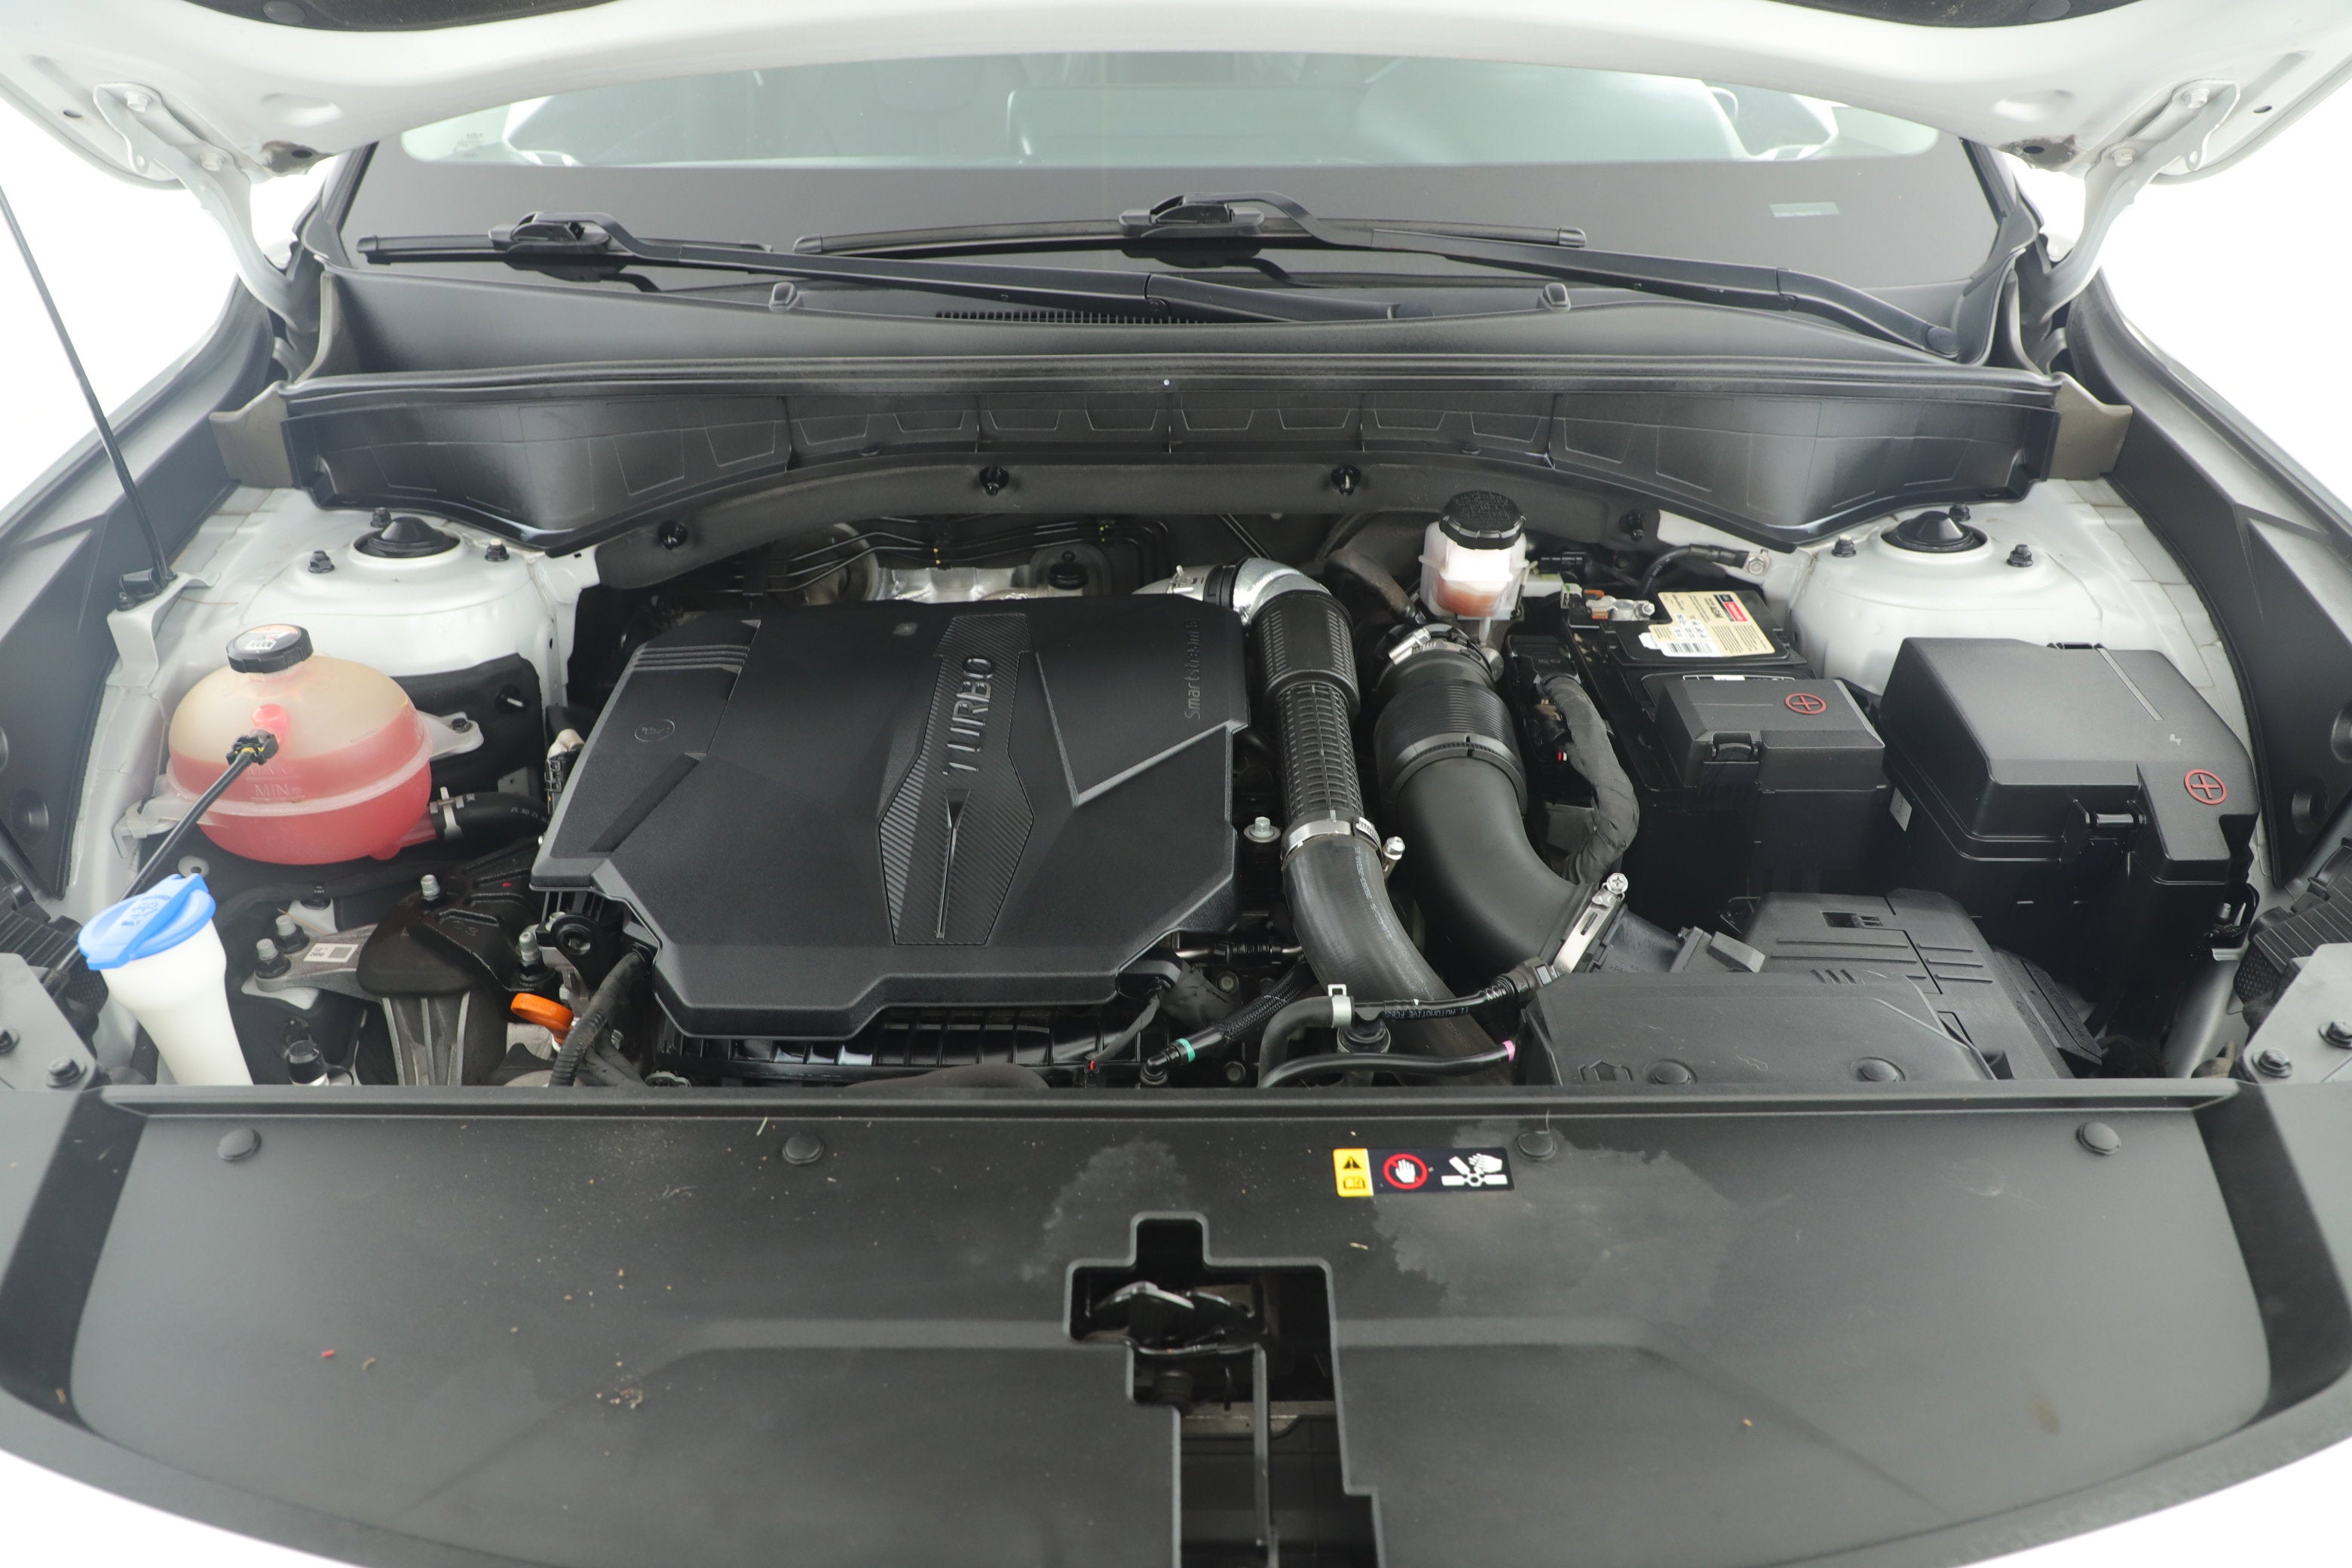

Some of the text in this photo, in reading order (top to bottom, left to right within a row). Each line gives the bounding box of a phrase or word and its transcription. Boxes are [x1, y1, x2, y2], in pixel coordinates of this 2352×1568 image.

[1184, 631, 1201, 720] Smartstream
[942, 657, 994, 776] TURBO
[254, 783, 289, 797] MIN
[1409, 1008, 1456, 1018] AUTOMOTIVE
